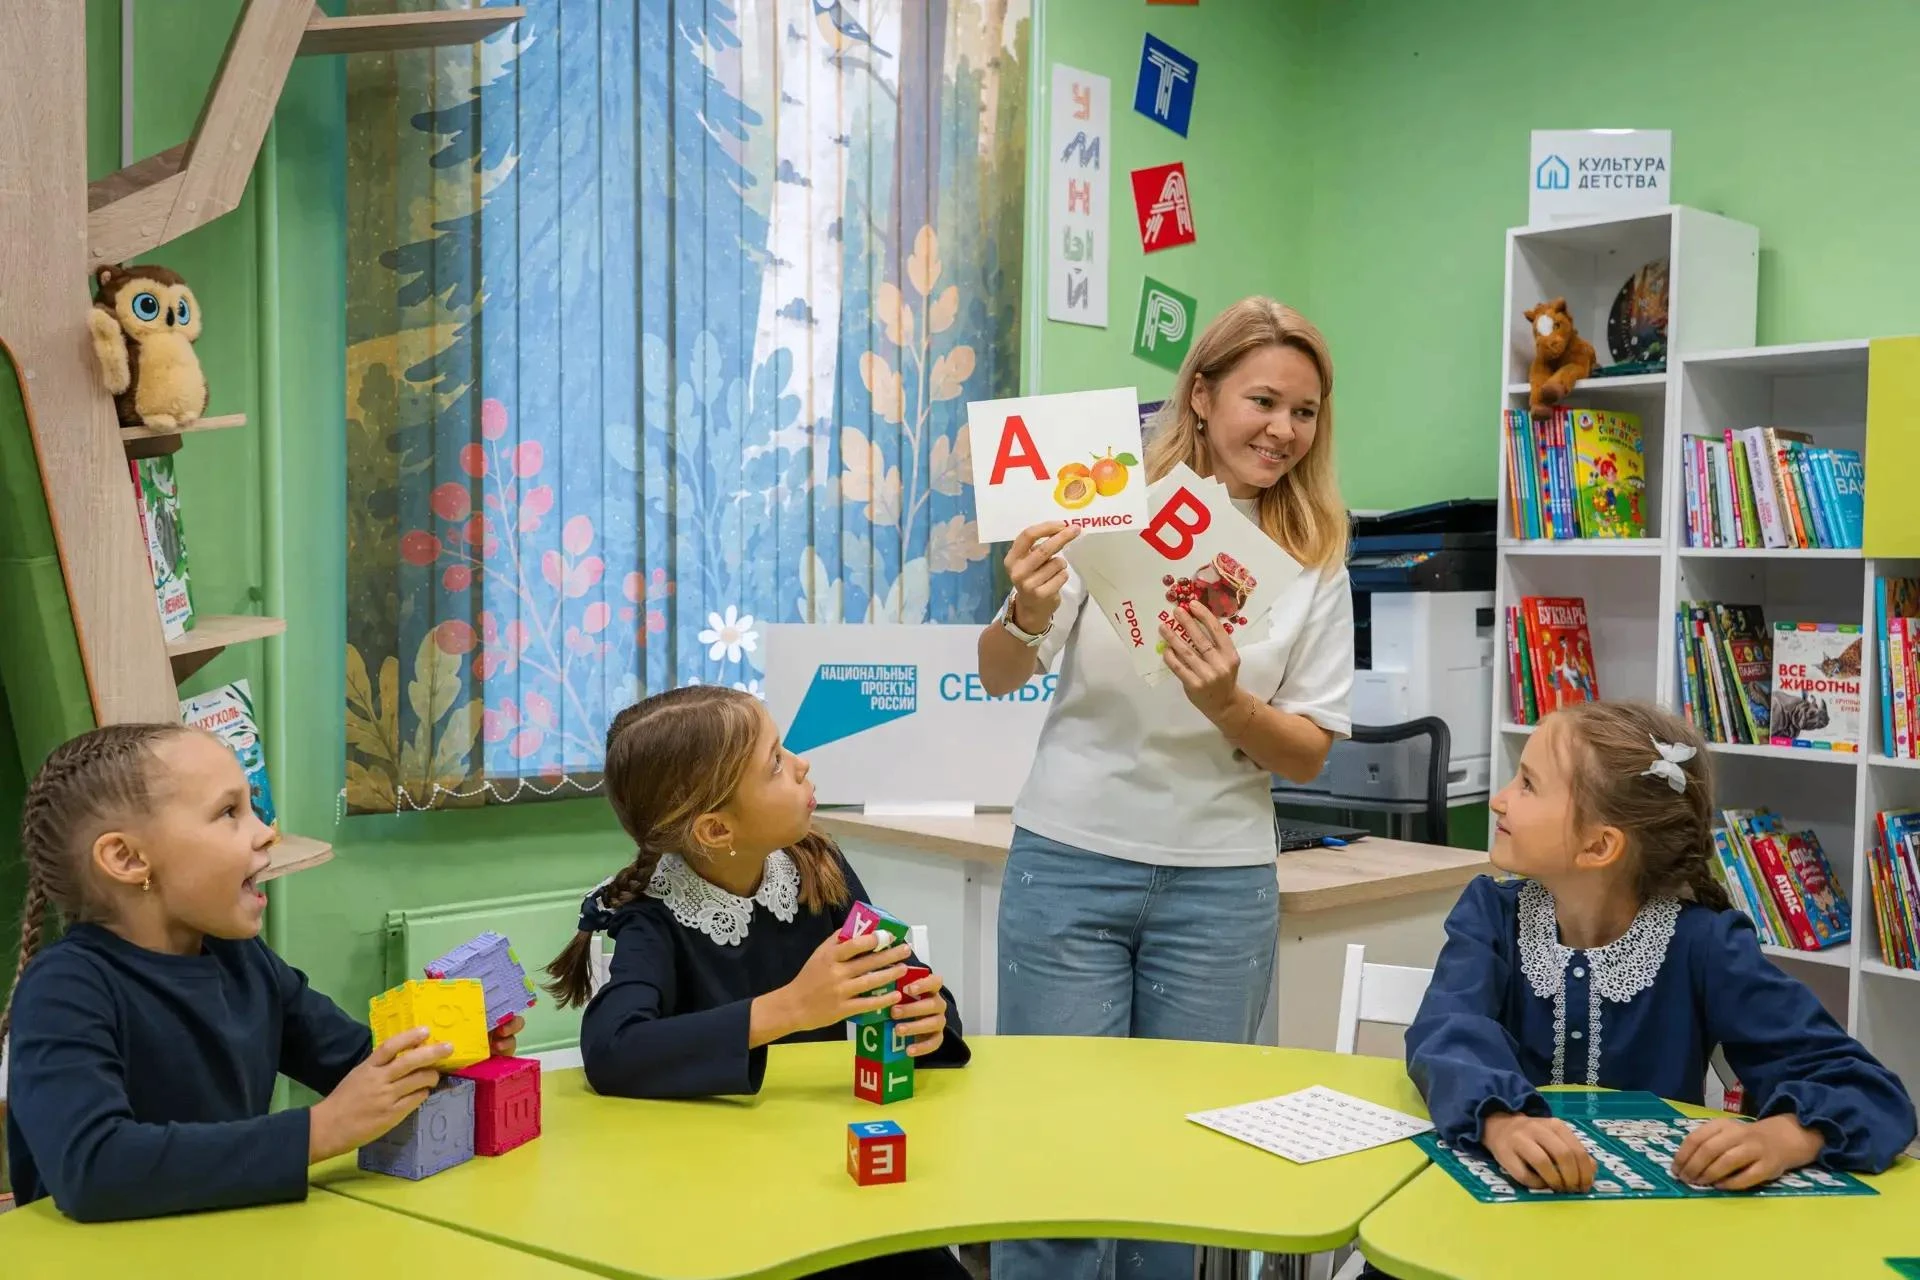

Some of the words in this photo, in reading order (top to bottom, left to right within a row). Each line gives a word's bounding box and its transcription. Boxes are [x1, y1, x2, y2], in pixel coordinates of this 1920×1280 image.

[1579, 157, 1666, 173] КУЛЬТУРА
[1060, 82, 1101, 310] УМНЫЙ
[1578, 174, 1658, 190] ДЕТСТВА
[1143, 170, 1193, 244] А
[1140, 288, 1188, 353] Р
[989, 415, 1051, 485] А
[1139, 486, 1212, 561] В
[1122, 601, 1145, 648] ГОРОХ
[1537, 605, 1587, 626] БУКВАРЬ
[1157, 610, 1203, 654] ВАРЕ
[821, 666, 915, 682] НАЦИОНАЛЬНЫЕ
[1778, 663, 1807, 678] ВСЕ
[861, 682, 915, 696] ПРОЕКТЫ
[870, 696, 915, 711] РОССИИ
[187, 706, 240, 732] ЫХУХОЛЬ
[1775, 874, 1801, 916] АТЛАС
[852, 911, 873, 940] А
[862, 1025, 878, 1053] С
[889, 1071, 908, 1093] Т
